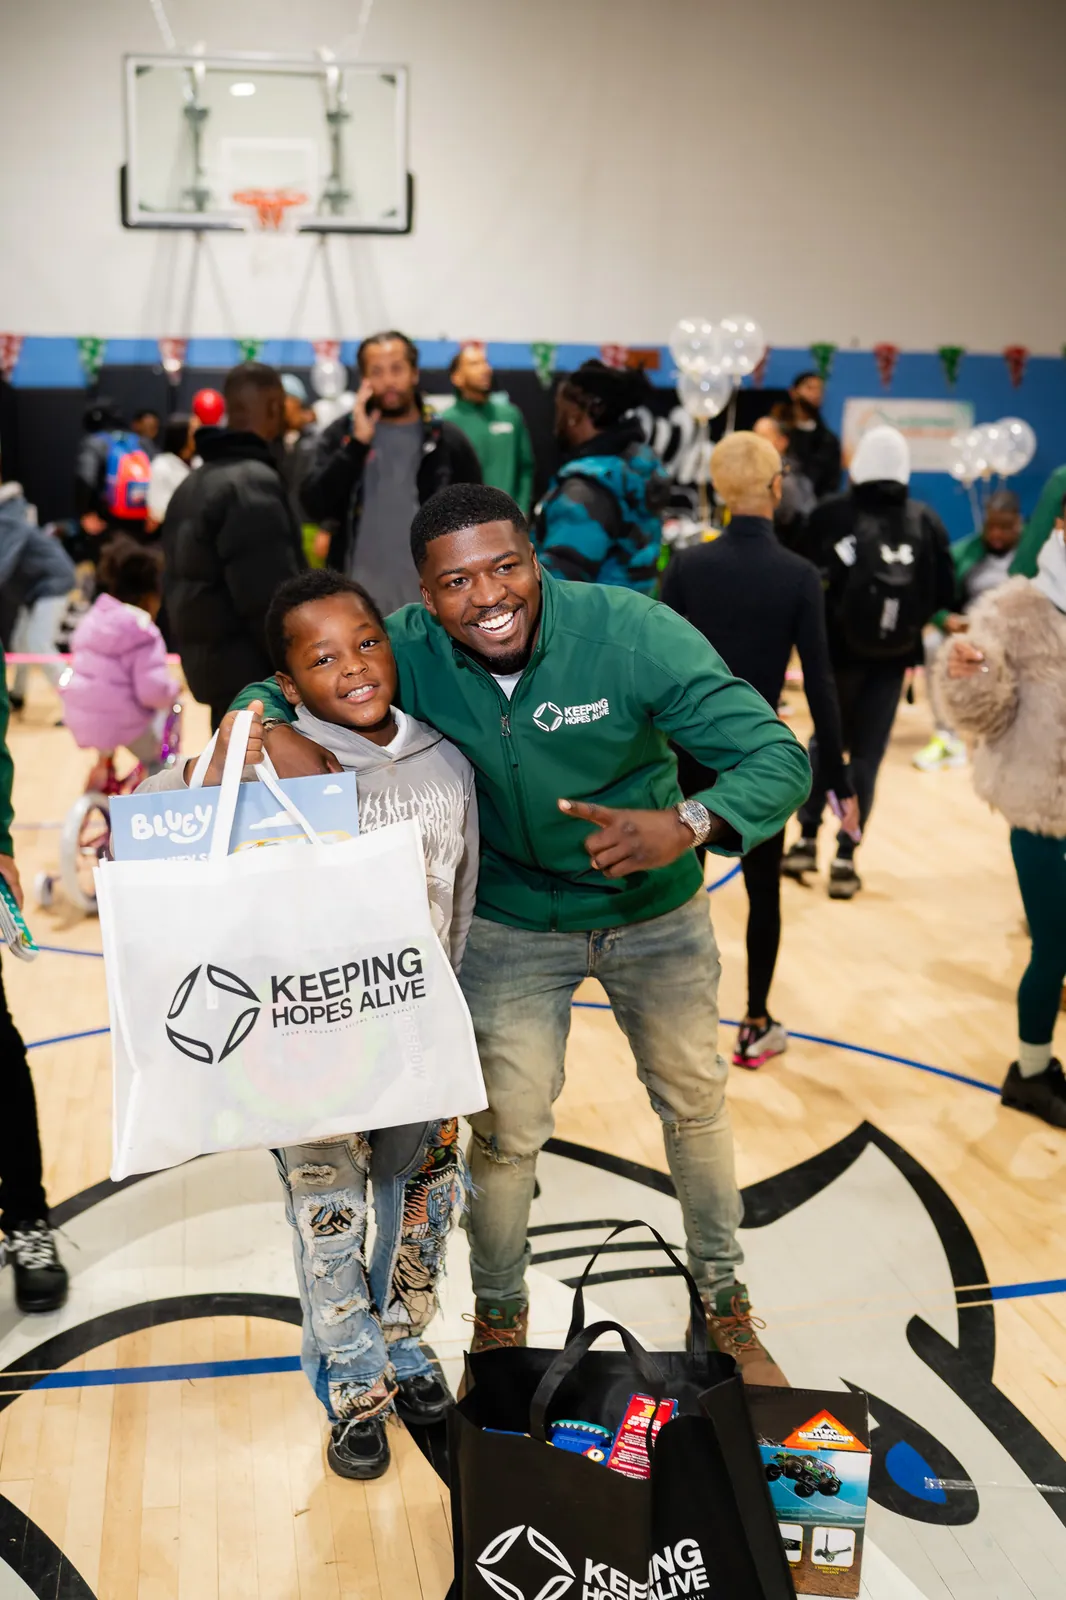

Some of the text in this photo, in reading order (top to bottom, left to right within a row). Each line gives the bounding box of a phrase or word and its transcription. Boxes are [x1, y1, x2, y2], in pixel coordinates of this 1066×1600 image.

[564, 698, 608, 716] KEEPING
[565, 708, 610, 725] HOPES ALIVE
[131, 804, 213, 844] BLUEY
[271, 947, 423, 1004] KEEPING
[272, 978, 426, 1028] HOPES ALIVE
